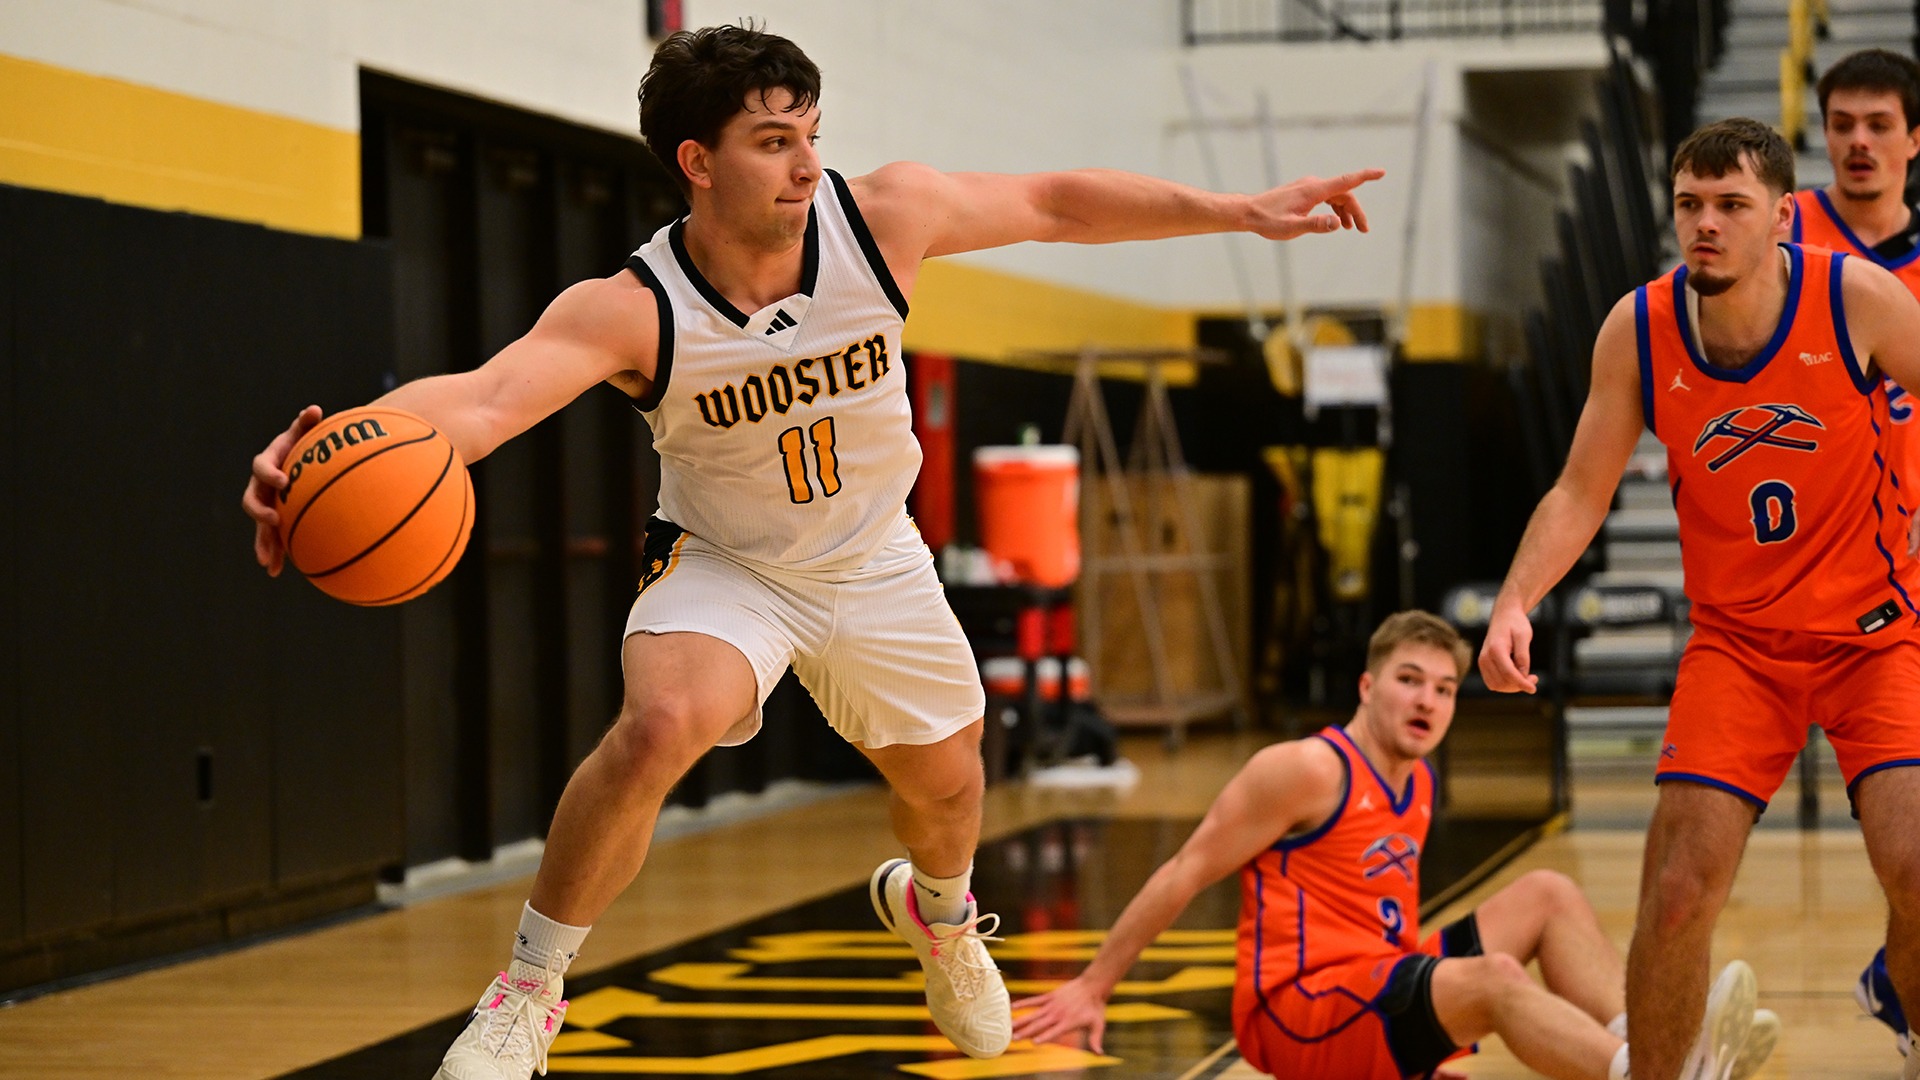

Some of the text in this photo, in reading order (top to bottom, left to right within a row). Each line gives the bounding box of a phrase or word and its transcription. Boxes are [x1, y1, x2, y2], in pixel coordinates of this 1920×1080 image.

[693, 333, 890, 429] WOOSTER
[777, 416, 842, 504] 11
[1748, 479, 1798, 546] 0
